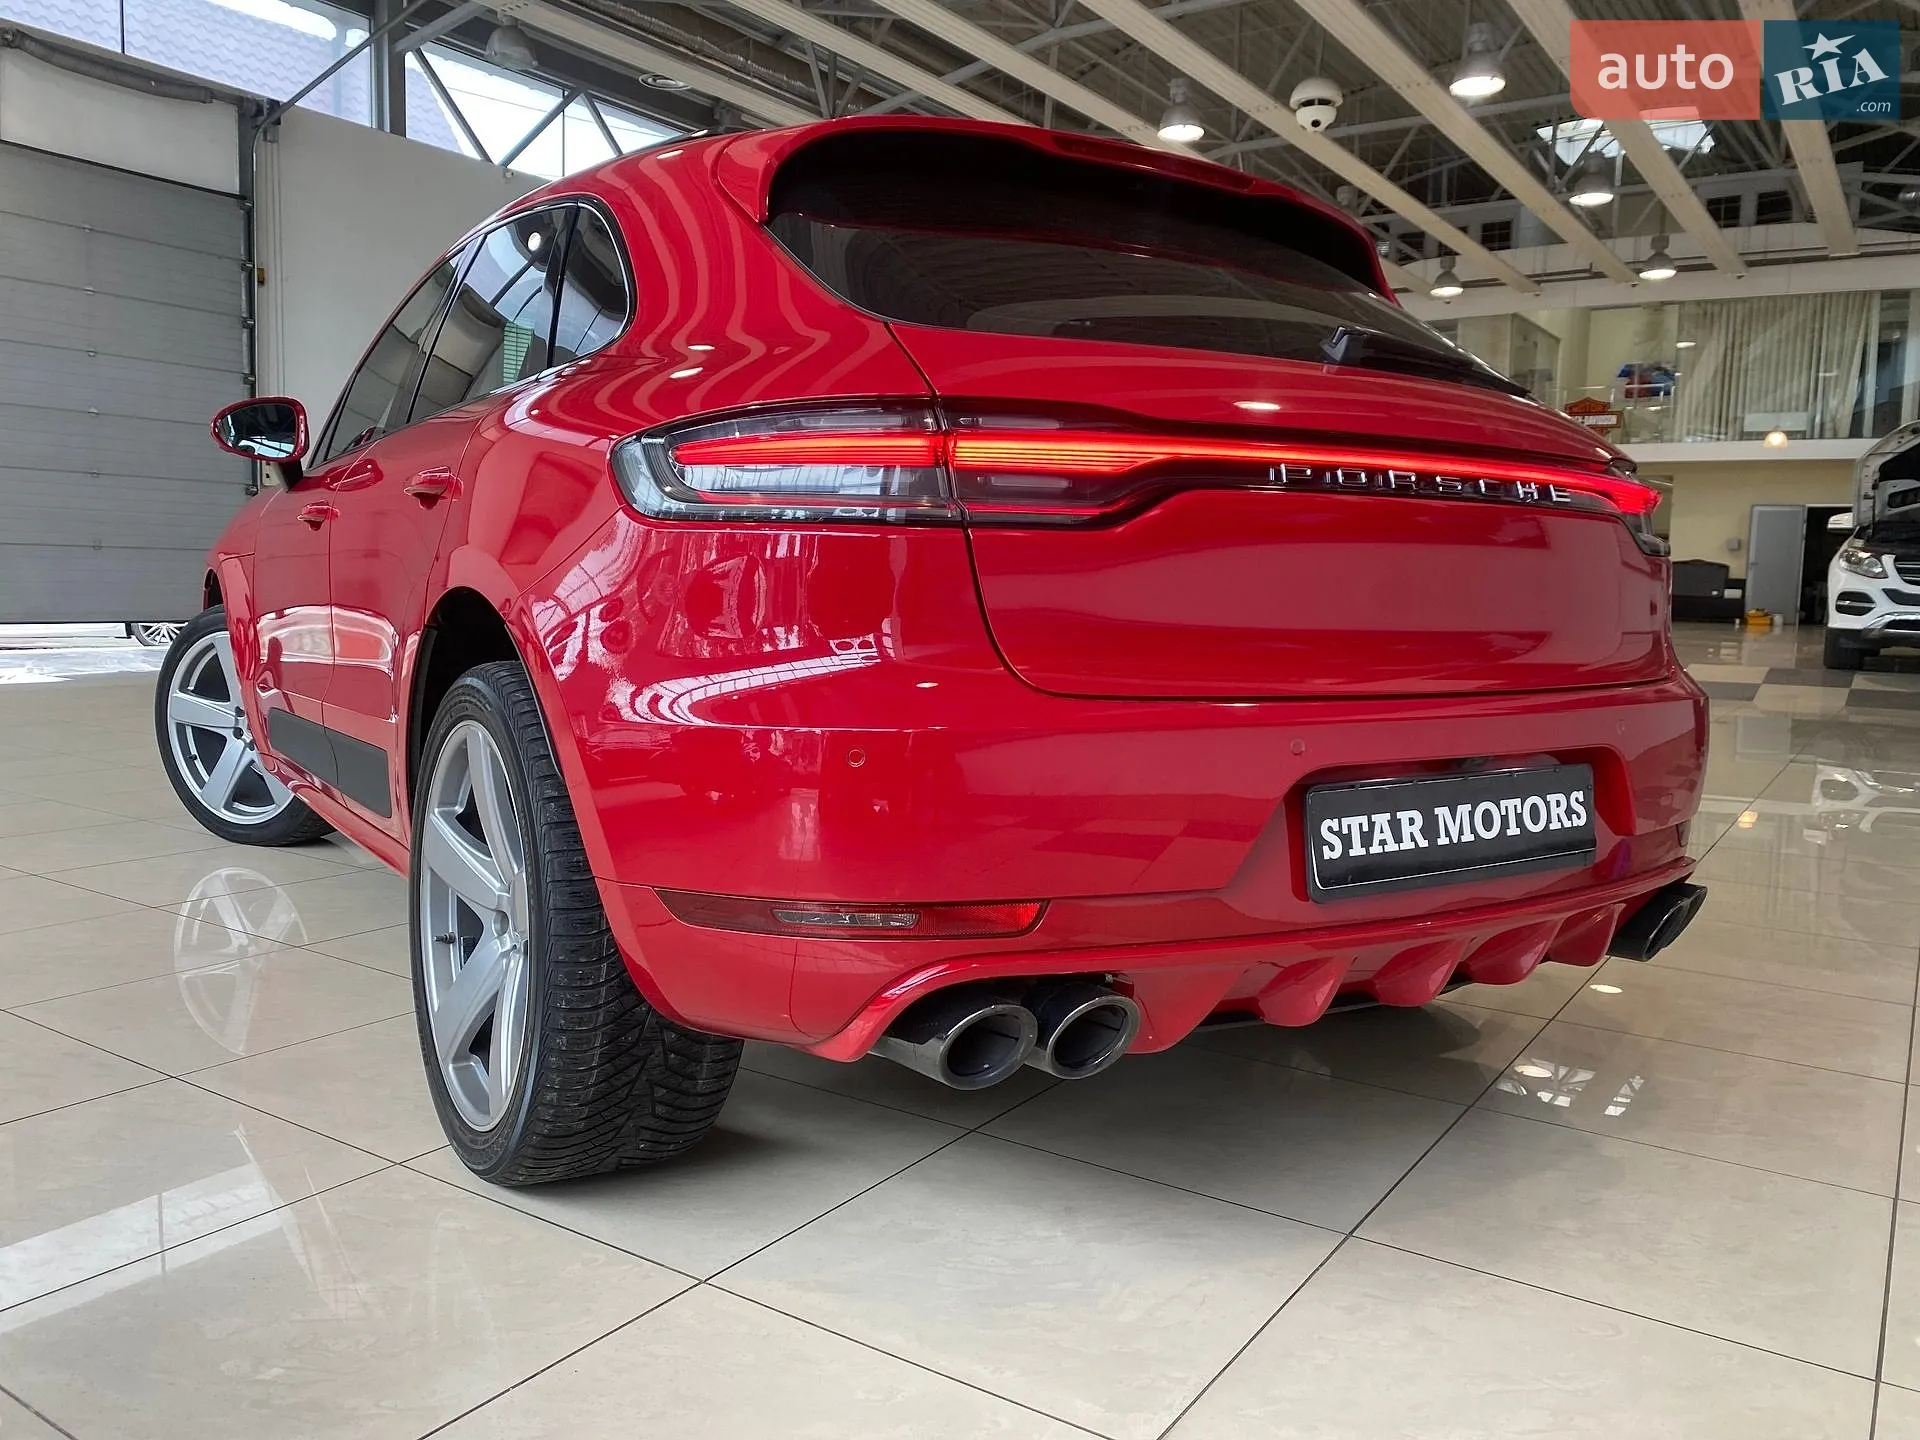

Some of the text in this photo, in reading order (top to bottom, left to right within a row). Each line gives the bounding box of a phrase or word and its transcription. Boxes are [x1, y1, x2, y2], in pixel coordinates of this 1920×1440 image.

[1273, 463, 1572, 503] PORSCHE
[1320, 790, 1588, 860] STAR MOTORS
